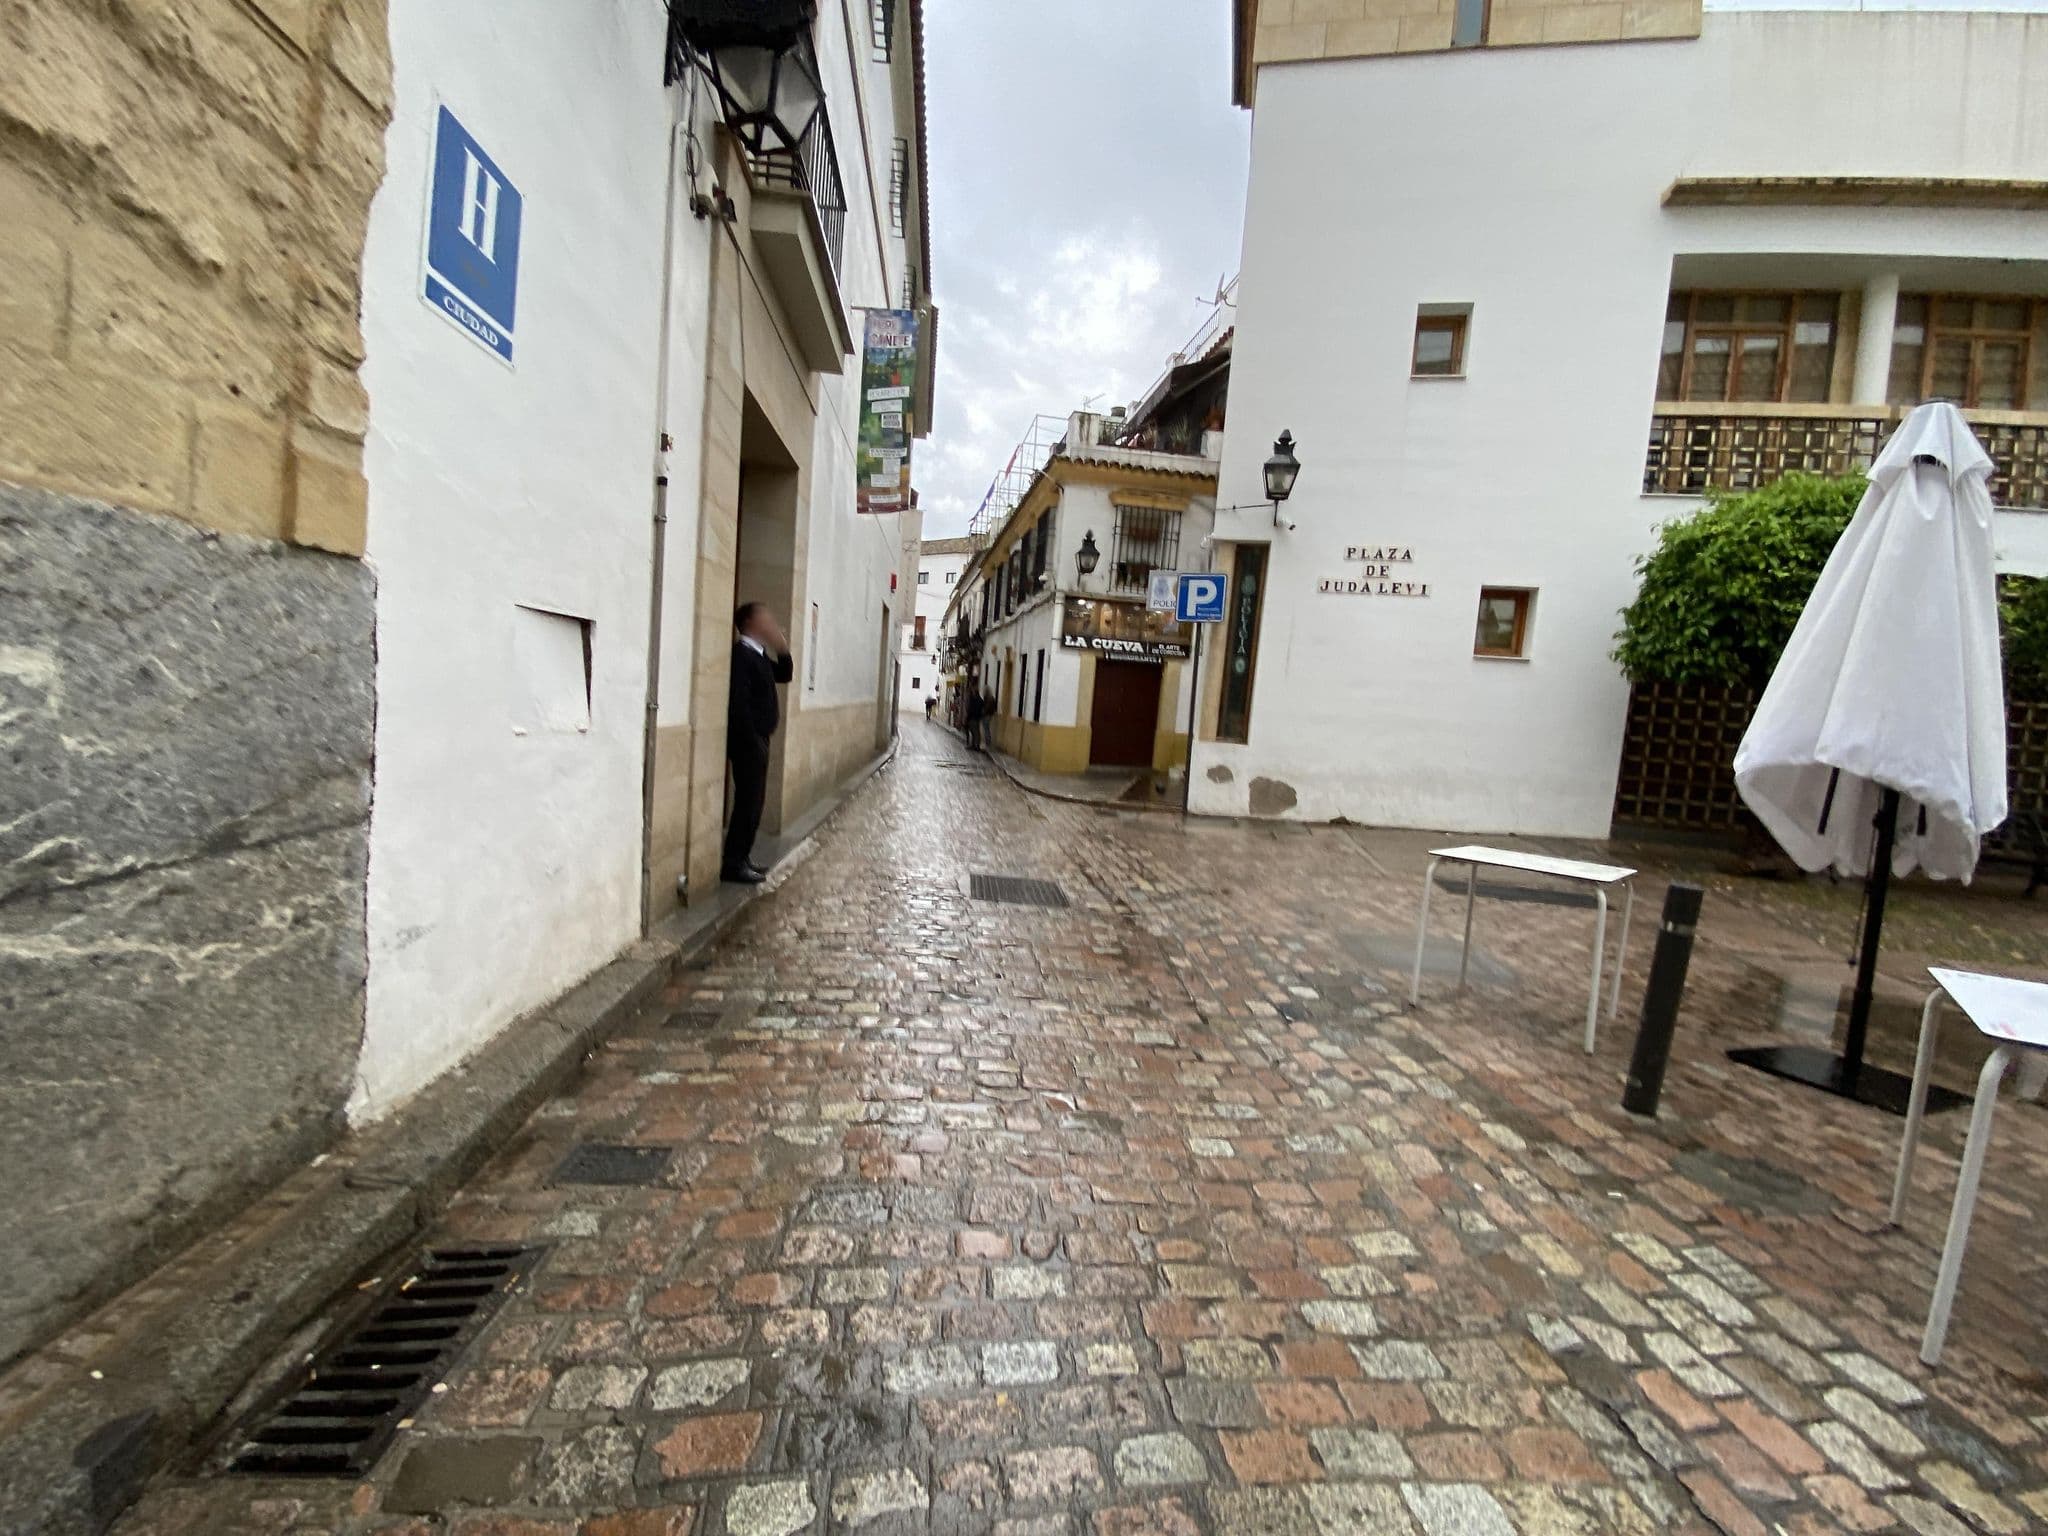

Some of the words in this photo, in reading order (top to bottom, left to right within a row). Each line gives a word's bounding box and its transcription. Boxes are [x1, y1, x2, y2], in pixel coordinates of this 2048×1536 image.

[458, 146, 502, 265] H
[443, 295, 499, 347] CIUDAD
[1346, 547, 1413, 560] PLAZA
[1366, 565, 1390, 577] DE
[1320, 580, 1371, 593] JUDA
[1377, 582, 1427, 595] LEVI
[1186, 579, 1218, 617] P
[1065, 635, 1087, 648] LA
[1091, 638, 1144, 653] CUEVA
